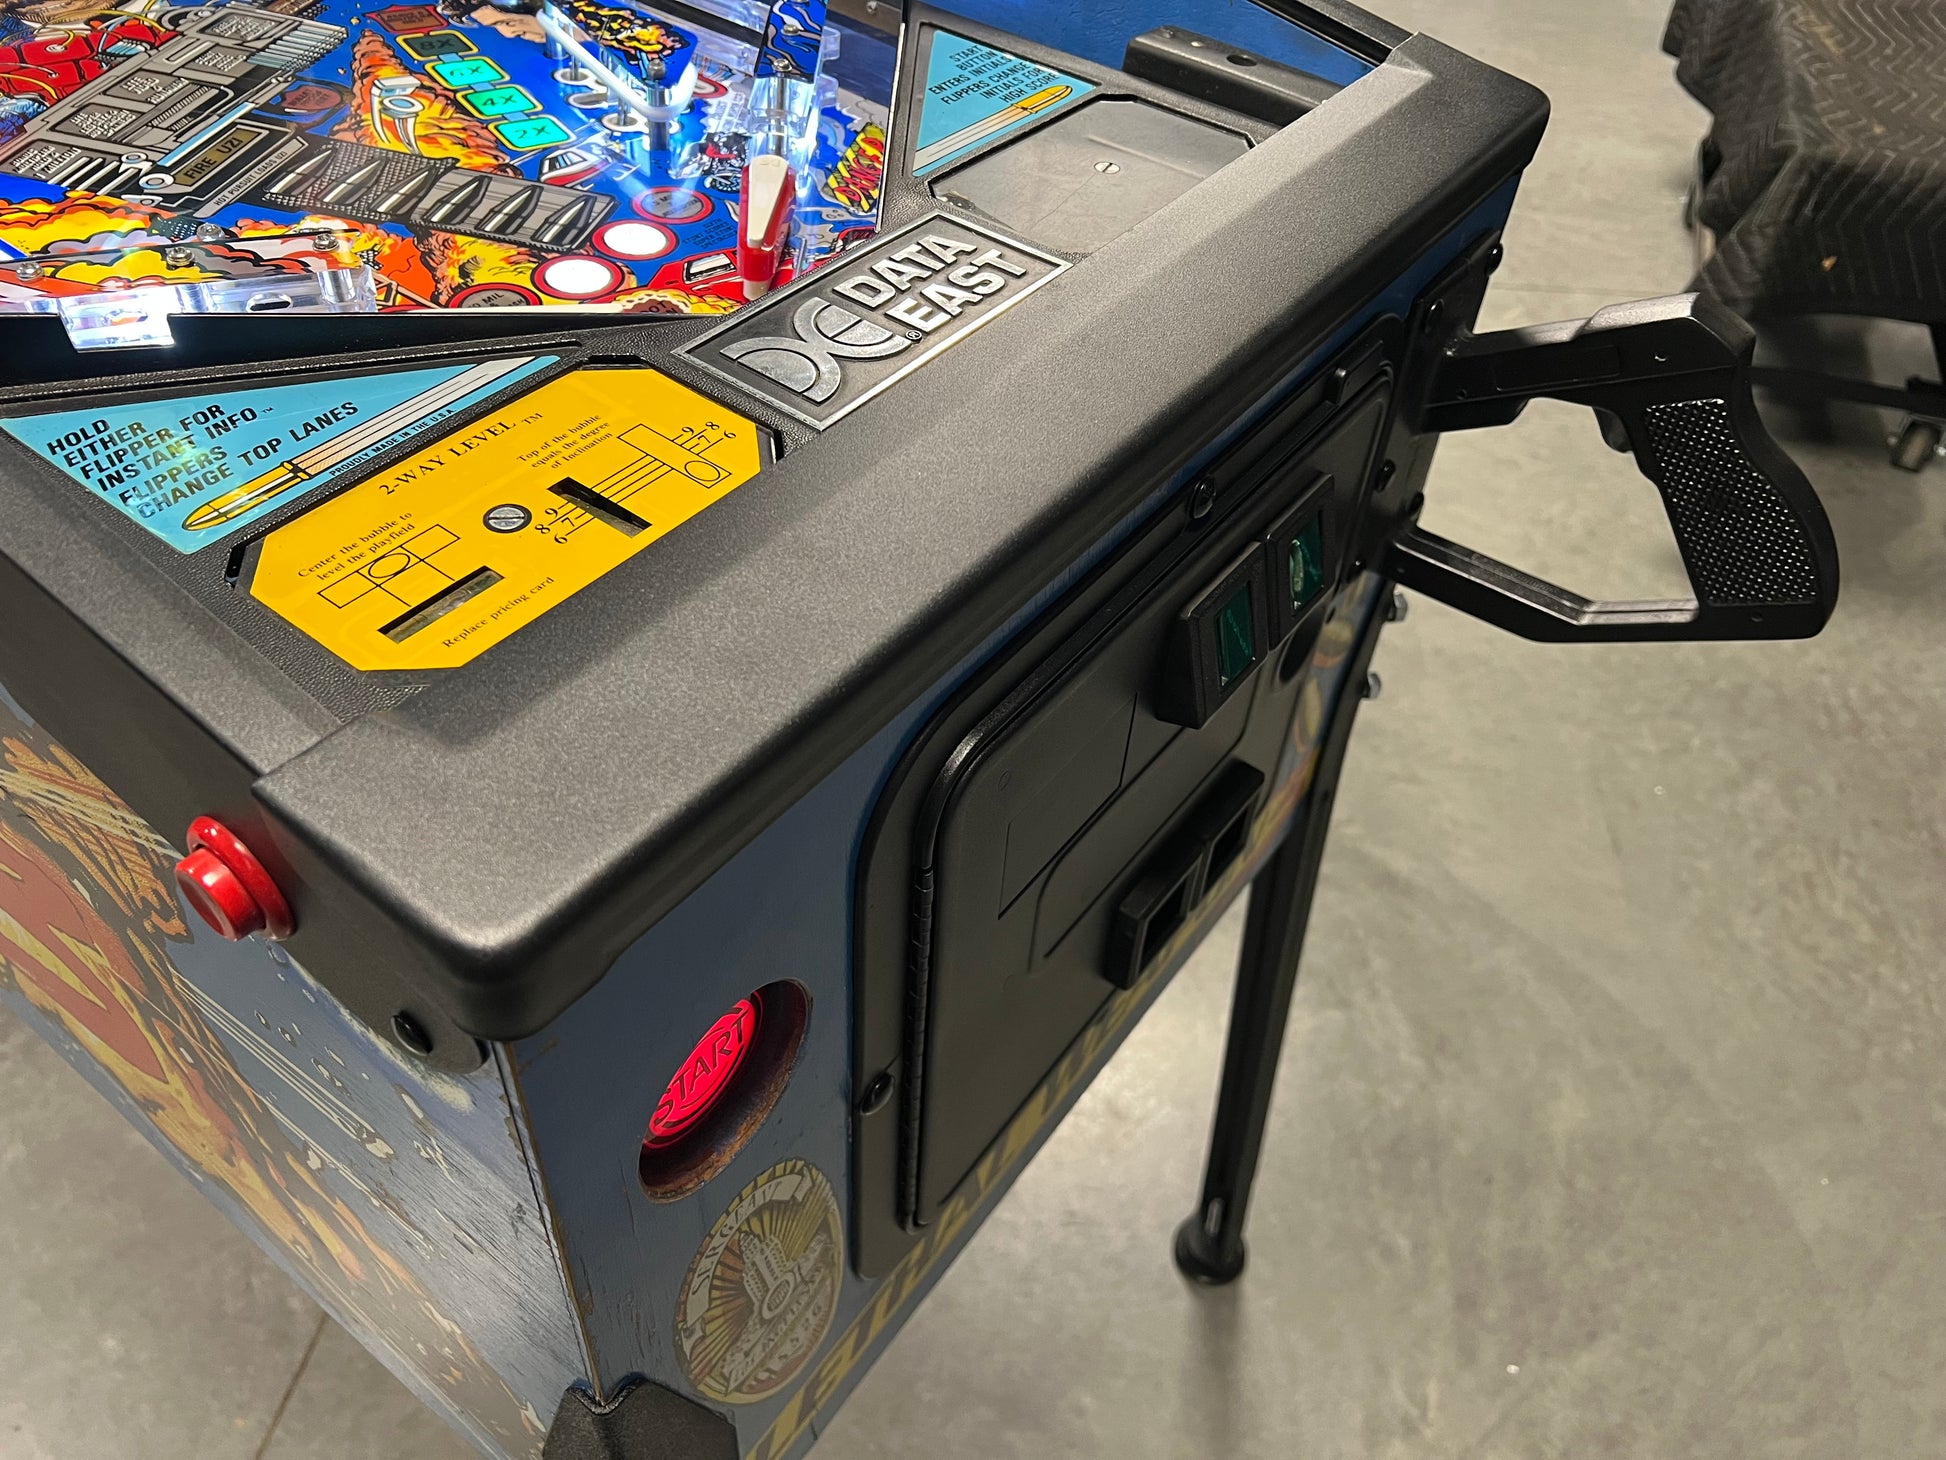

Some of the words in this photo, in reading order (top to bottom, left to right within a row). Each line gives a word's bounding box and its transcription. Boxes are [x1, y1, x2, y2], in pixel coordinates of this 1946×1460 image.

[420, 38, 456, 51] 8X
[950, 44, 983, 62] START
[956, 50, 997, 71] BUTTON
[928, 74, 970, 95] ENTERS
[970, 56, 1013, 77] INITIALS
[940, 80, 990, 105] FLIPPERS
[989, 62, 1032, 83] CHANGE
[980, 77, 1024, 99] INITIALS
[1024, 67, 1046, 81] FOR
[1000, 88, 1027, 103] HIGH
[1027, 72, 1060, 91] SCORE
[482, 93, 517, 107] 4X
[514, 124, 550, 139] 2X
[184, 157, 218, 179] FIRE
[216, 137, 243, 154] UZI
[214, 194, 229, 206] HOT
[228, 175, 257, 197] PURSUIT
[255, 159, 275, 175] LOADS
[274, 150, 288, 161] UZI
[833, 234, 977, 309] DATA
[885, 247, 1027, 333] EAST
[482, 292, 504, 304] MIL
[47, 418, 110, 456] HOLD
[64, 421, 147, 468] EITHER
[79, 427, 174, 480] FLIPPER
[179, 404, 225, 431] FOR
[329, 451, 371, 477] PROUDLY
[371, 435, 398, 453] MADE
[398, 430, 411, 440] IN
[411, 419, 431, 434] THE
[429, 408, 456, 424] U.S.A.
[516, 447, 540, 463] Top
[540, 440, 552, 451] of
[552, 431, 570, 444] the
[569, 414, 602, 437] bubble
[531, 448, 563, 468] equals
[562, 437, 580, 451] the
[580, 421, 611, 443] degree
[681, 426, 695, 439] 9
[697, 434, 712, 445] 7
[705, 421, 720, 431] 8
[723, 430, 737, 439] 6
[97, 434, 198, 491] INSTANT
[205, 407, 258, 440] INFO
[136, 462, 235, 518] CHANGE
[237, 437, 282, 466] TOP
[288, 401, 359, 442] LANES
[379, 454, 445, 495] 2-WAY
[447, 418, 518, 457] LEVEL
[521, 412, 544, 426] TM
[550, 459, 562, 469] of
[562, 431, 613, 463] Inclination
[119, 445, 228, 507] FLIPPERS
[534, 524, 551, 535] 8
[545, 507, 559, 518] 9
[561, 517, 575, 529] 7
[297, 552, 338, 579] Center
[339, 541, 359, 555] the
[359, 521, 398, 547] bubble
[399, 512, 413, 523] to
[316, 564, 346, 582] level
[347, 551, 367, 566] the
[368, 523, 416, 555] playfield
[554, 534, 568, 544] 6
[441, 618, 489, 649] Replace
[489, 591, 530, 621] pricing
[529, 576, 554, 594] card
[653, 1009, 750, 1126] START
